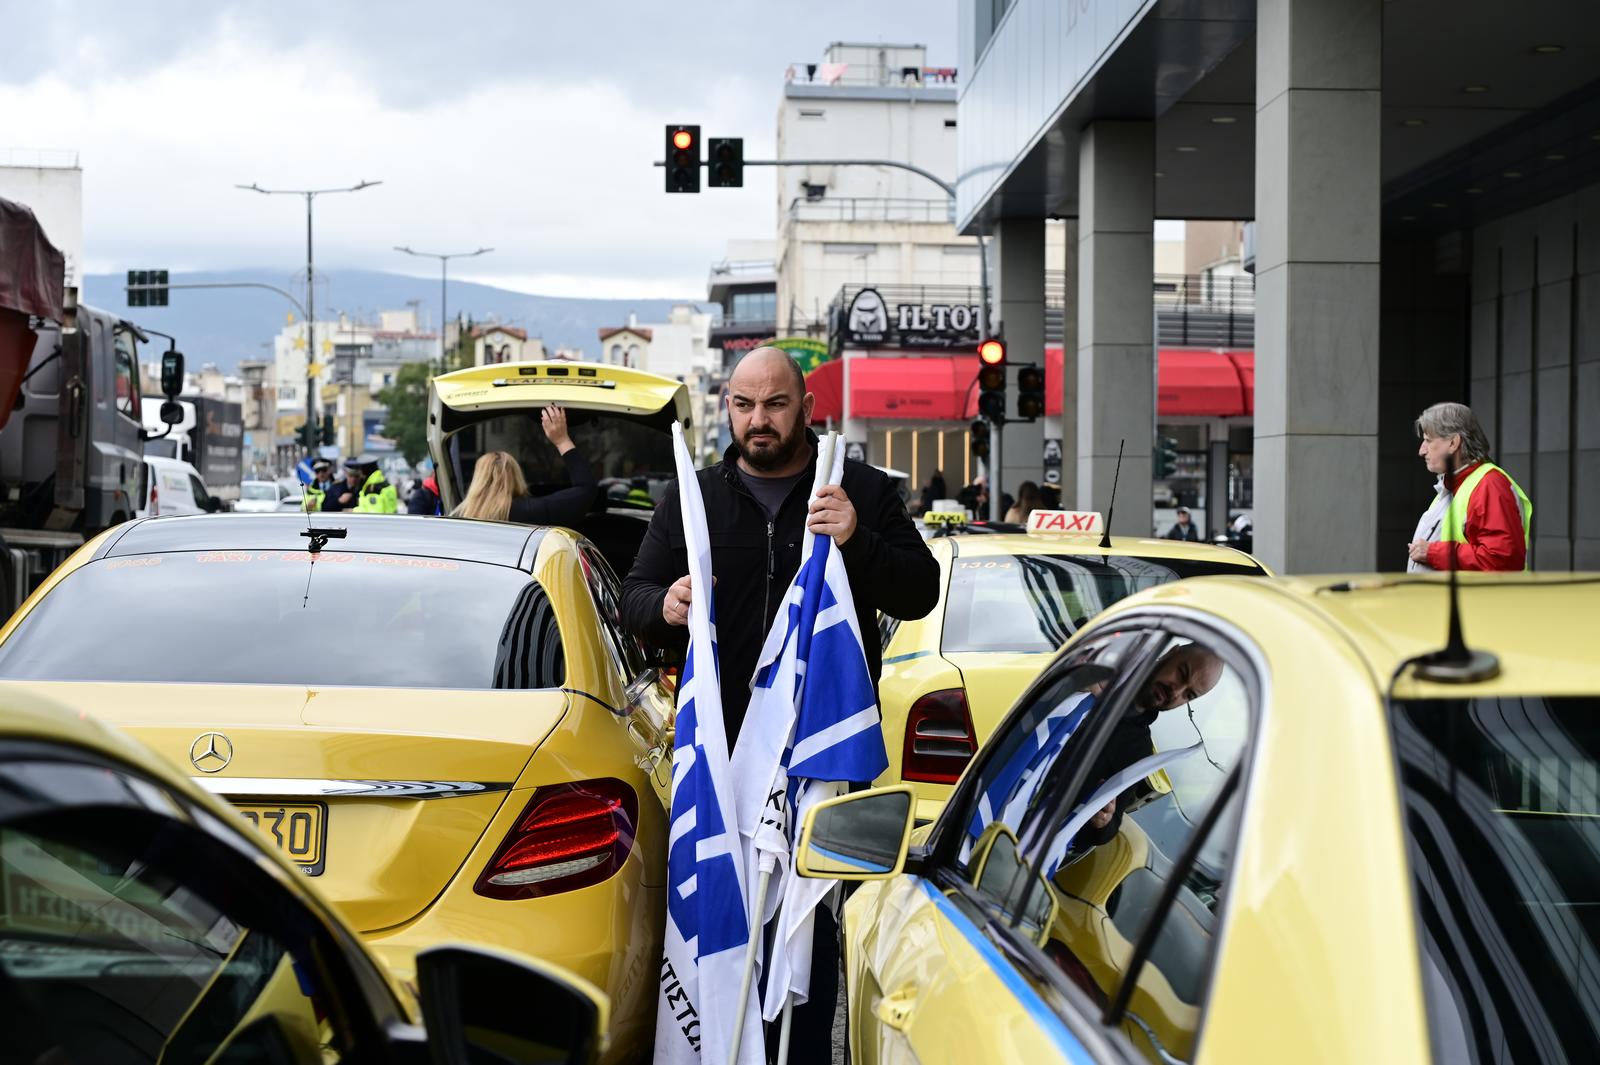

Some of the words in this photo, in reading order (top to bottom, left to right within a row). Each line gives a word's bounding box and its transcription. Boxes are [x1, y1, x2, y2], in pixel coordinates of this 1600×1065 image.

[898, 305, 929, 331] IL
[932, 305, 984, 331] TOT
[931, 514, 961, 522] TAXI
[1035, 513, 1095, 531] TAXI
[661, 956, 702, 1053] ΤΙΣΤΩ
